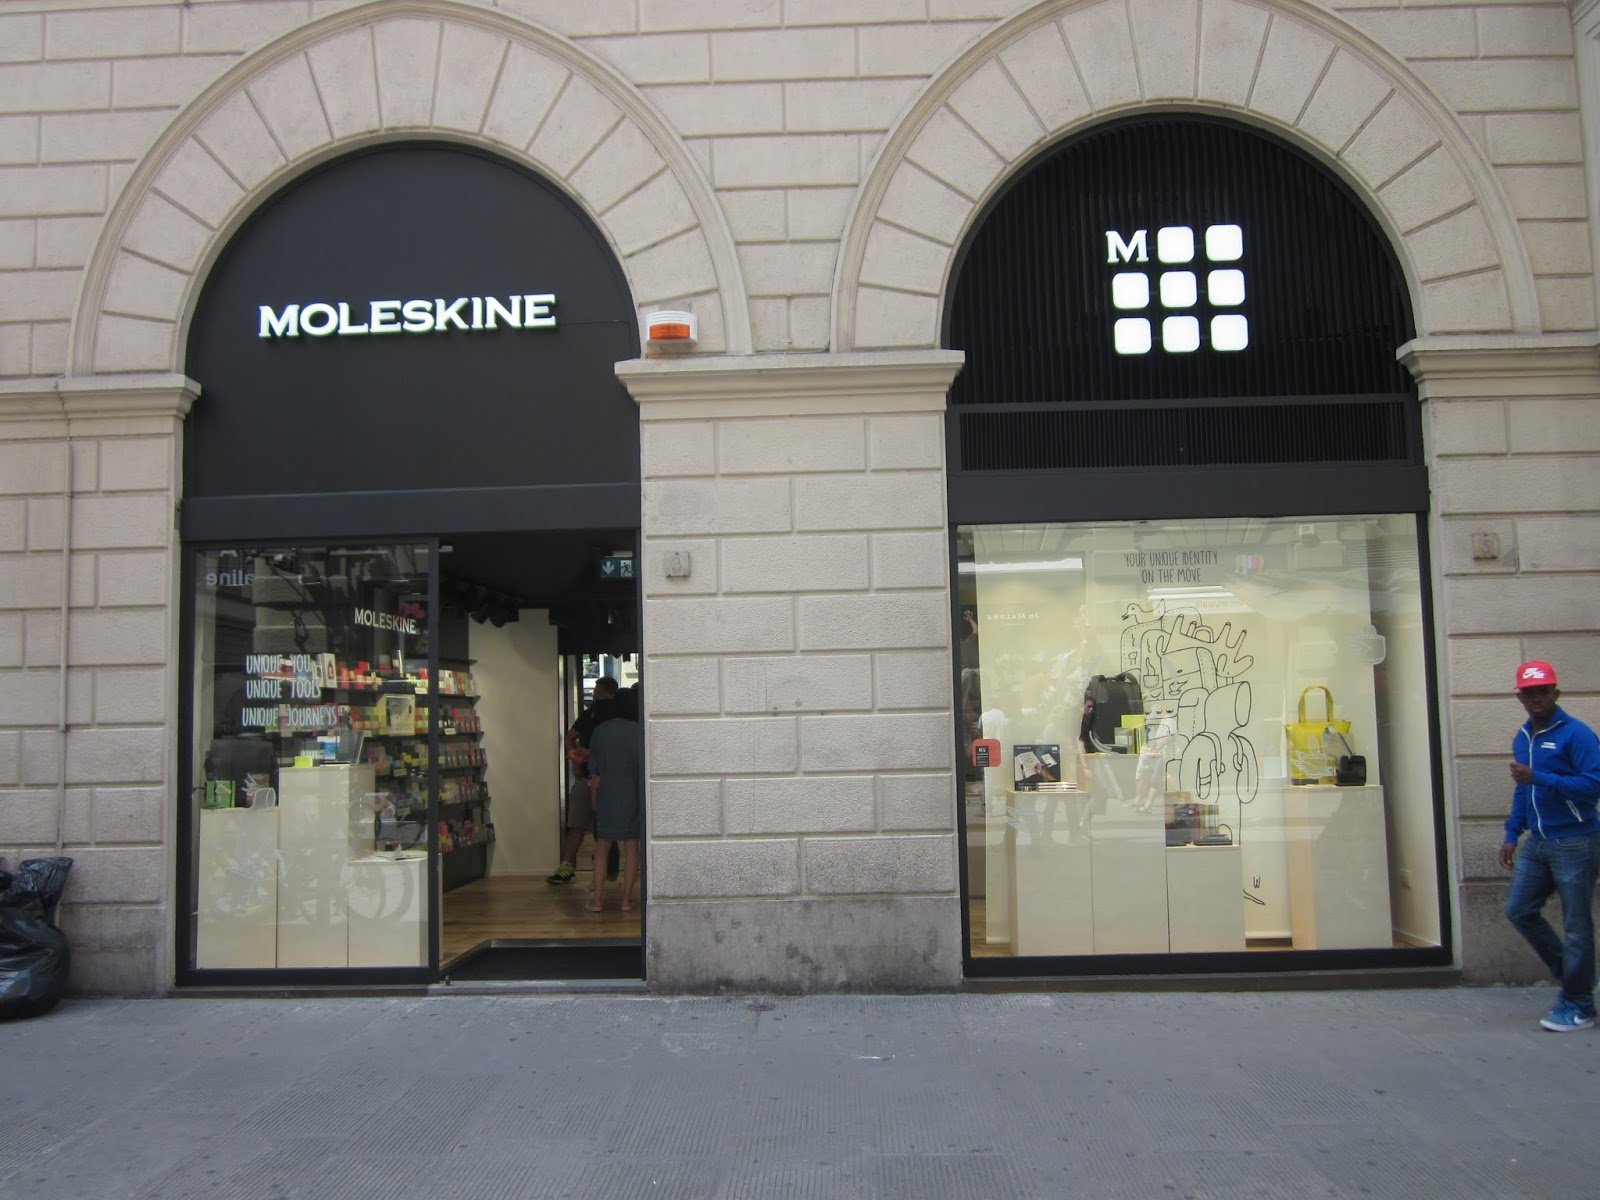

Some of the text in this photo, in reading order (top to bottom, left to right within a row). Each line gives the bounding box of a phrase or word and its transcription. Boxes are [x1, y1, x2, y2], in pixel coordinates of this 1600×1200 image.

[259, 294, 556, 338] MOLESKINE
[1124, 550, 1217, 567] YOUR UNIQUE IDENTITY
[1142, 567, 1201, 583] ON THE MOVE
[354, 607, 416, 634] MOLESKINE
[246, 654, 311, 673] UNIQUE YOU
[246, 680, 321, 699] UNIQUE TOOLS
[242, 706, 337, 726] UNIQUE JOURNEYS
